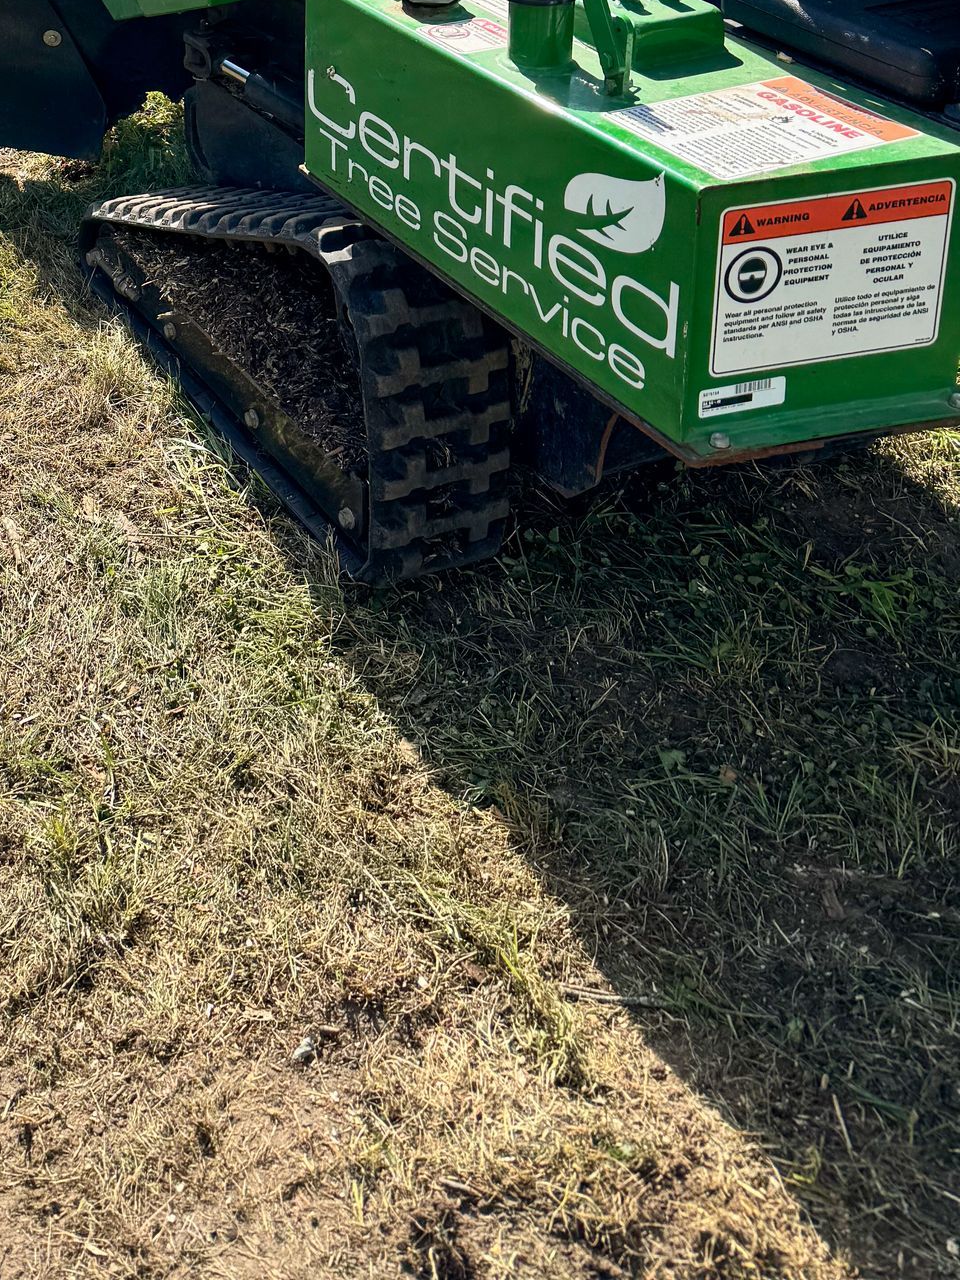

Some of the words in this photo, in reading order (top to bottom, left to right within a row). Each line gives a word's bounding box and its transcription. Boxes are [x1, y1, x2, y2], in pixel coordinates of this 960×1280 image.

[756, 91, 865, 139] GASOLINE
[868, 193, 946, 212] ADVERTENCIA
[306, 66, 680, 359] Certified
[756, 212, 810, 227] WARNING
[878, 231, 908, 241] UTILICE
[786, 245, 809, 254] WEAR
[810, 243, 826, 251] EYE
[863, 240, 921, 254] EQUIPAMIENTO
[319, 127, 422, 231] Tree
[432, 210, 646, 390] Service
[788, 253, 830, 265] PERSONAL
[860, 257, 871, 265] DE
[872, 250, 922, 263] PROTECCIÓN
[783, 263, 833, 276] PROTECTION
[865, 263, 905, 274] PERSONAL
[907, 261, 914, 269] Y
[784, 274, 830, 286] EQUIPMENT
[872, 273, 904, 284] OCULAR
[834, 296, 856, 304] Utilice
[857, 292, 872, 300] todo
[881, 285, 926, 297] equipamiento
[926, 283, 936, 291] de
[724, 312, 742, 320] Wear
[743, 309, 752, 317] all
[753, 305, 783, 317] personal
[783, 300, 818, 312] protection
[833, 300, 869, 312] protección
[870, 296, 900, 307] personal
[724, 317, 760, 328] equipment
[760, 313, 774, 322] and
[775, 312, 796, 320] follow
[806, 307, 827, 315] safety
[832, 319, 857, 327] normas
[868, 311, 901, 322] seguridad
[912, 307, 929, 315] ANSI
[833, 311, 851, 319] todas
[853, 309, 863, 317] las
[723, 325, 757, 335] standards
[758, 323, 770, 331] per
[770, 320, 788, 329] ANSI
[789, 318, 802, 326] and
[803, 315, 824, 324] OSHA
